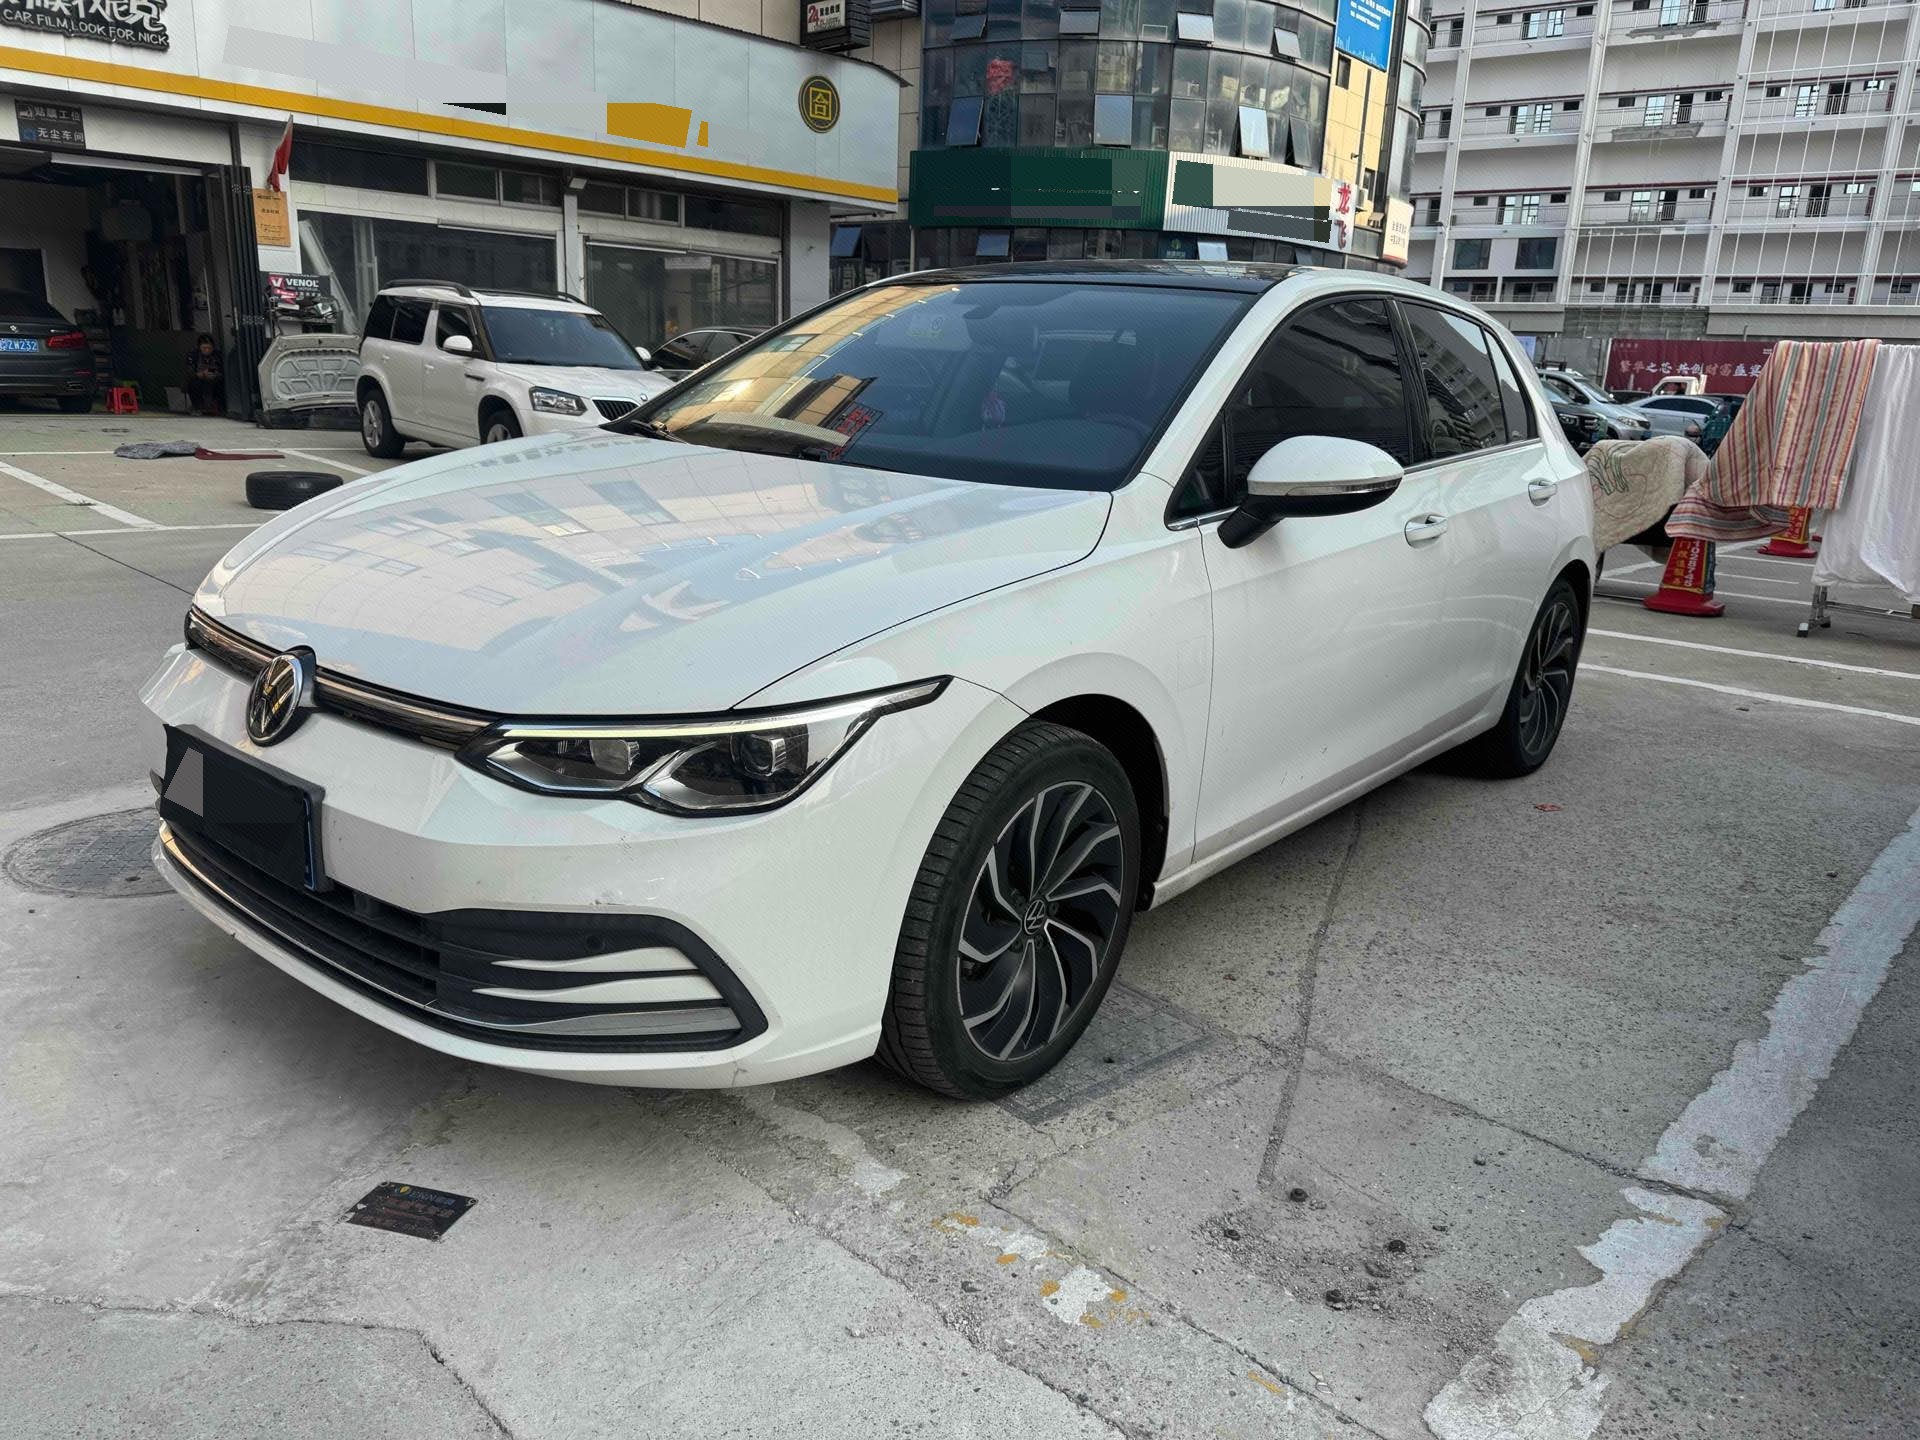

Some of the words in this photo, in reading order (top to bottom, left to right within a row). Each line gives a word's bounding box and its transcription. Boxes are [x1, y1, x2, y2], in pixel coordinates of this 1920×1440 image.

[3, 8, 34, 25] CAR
[109, 26, 136, 42] FOR
[138, 31, 168, 46] NICK
[37, 127, 84, 142] 无尘车间
[286, 278, 319, 287] VENOL
